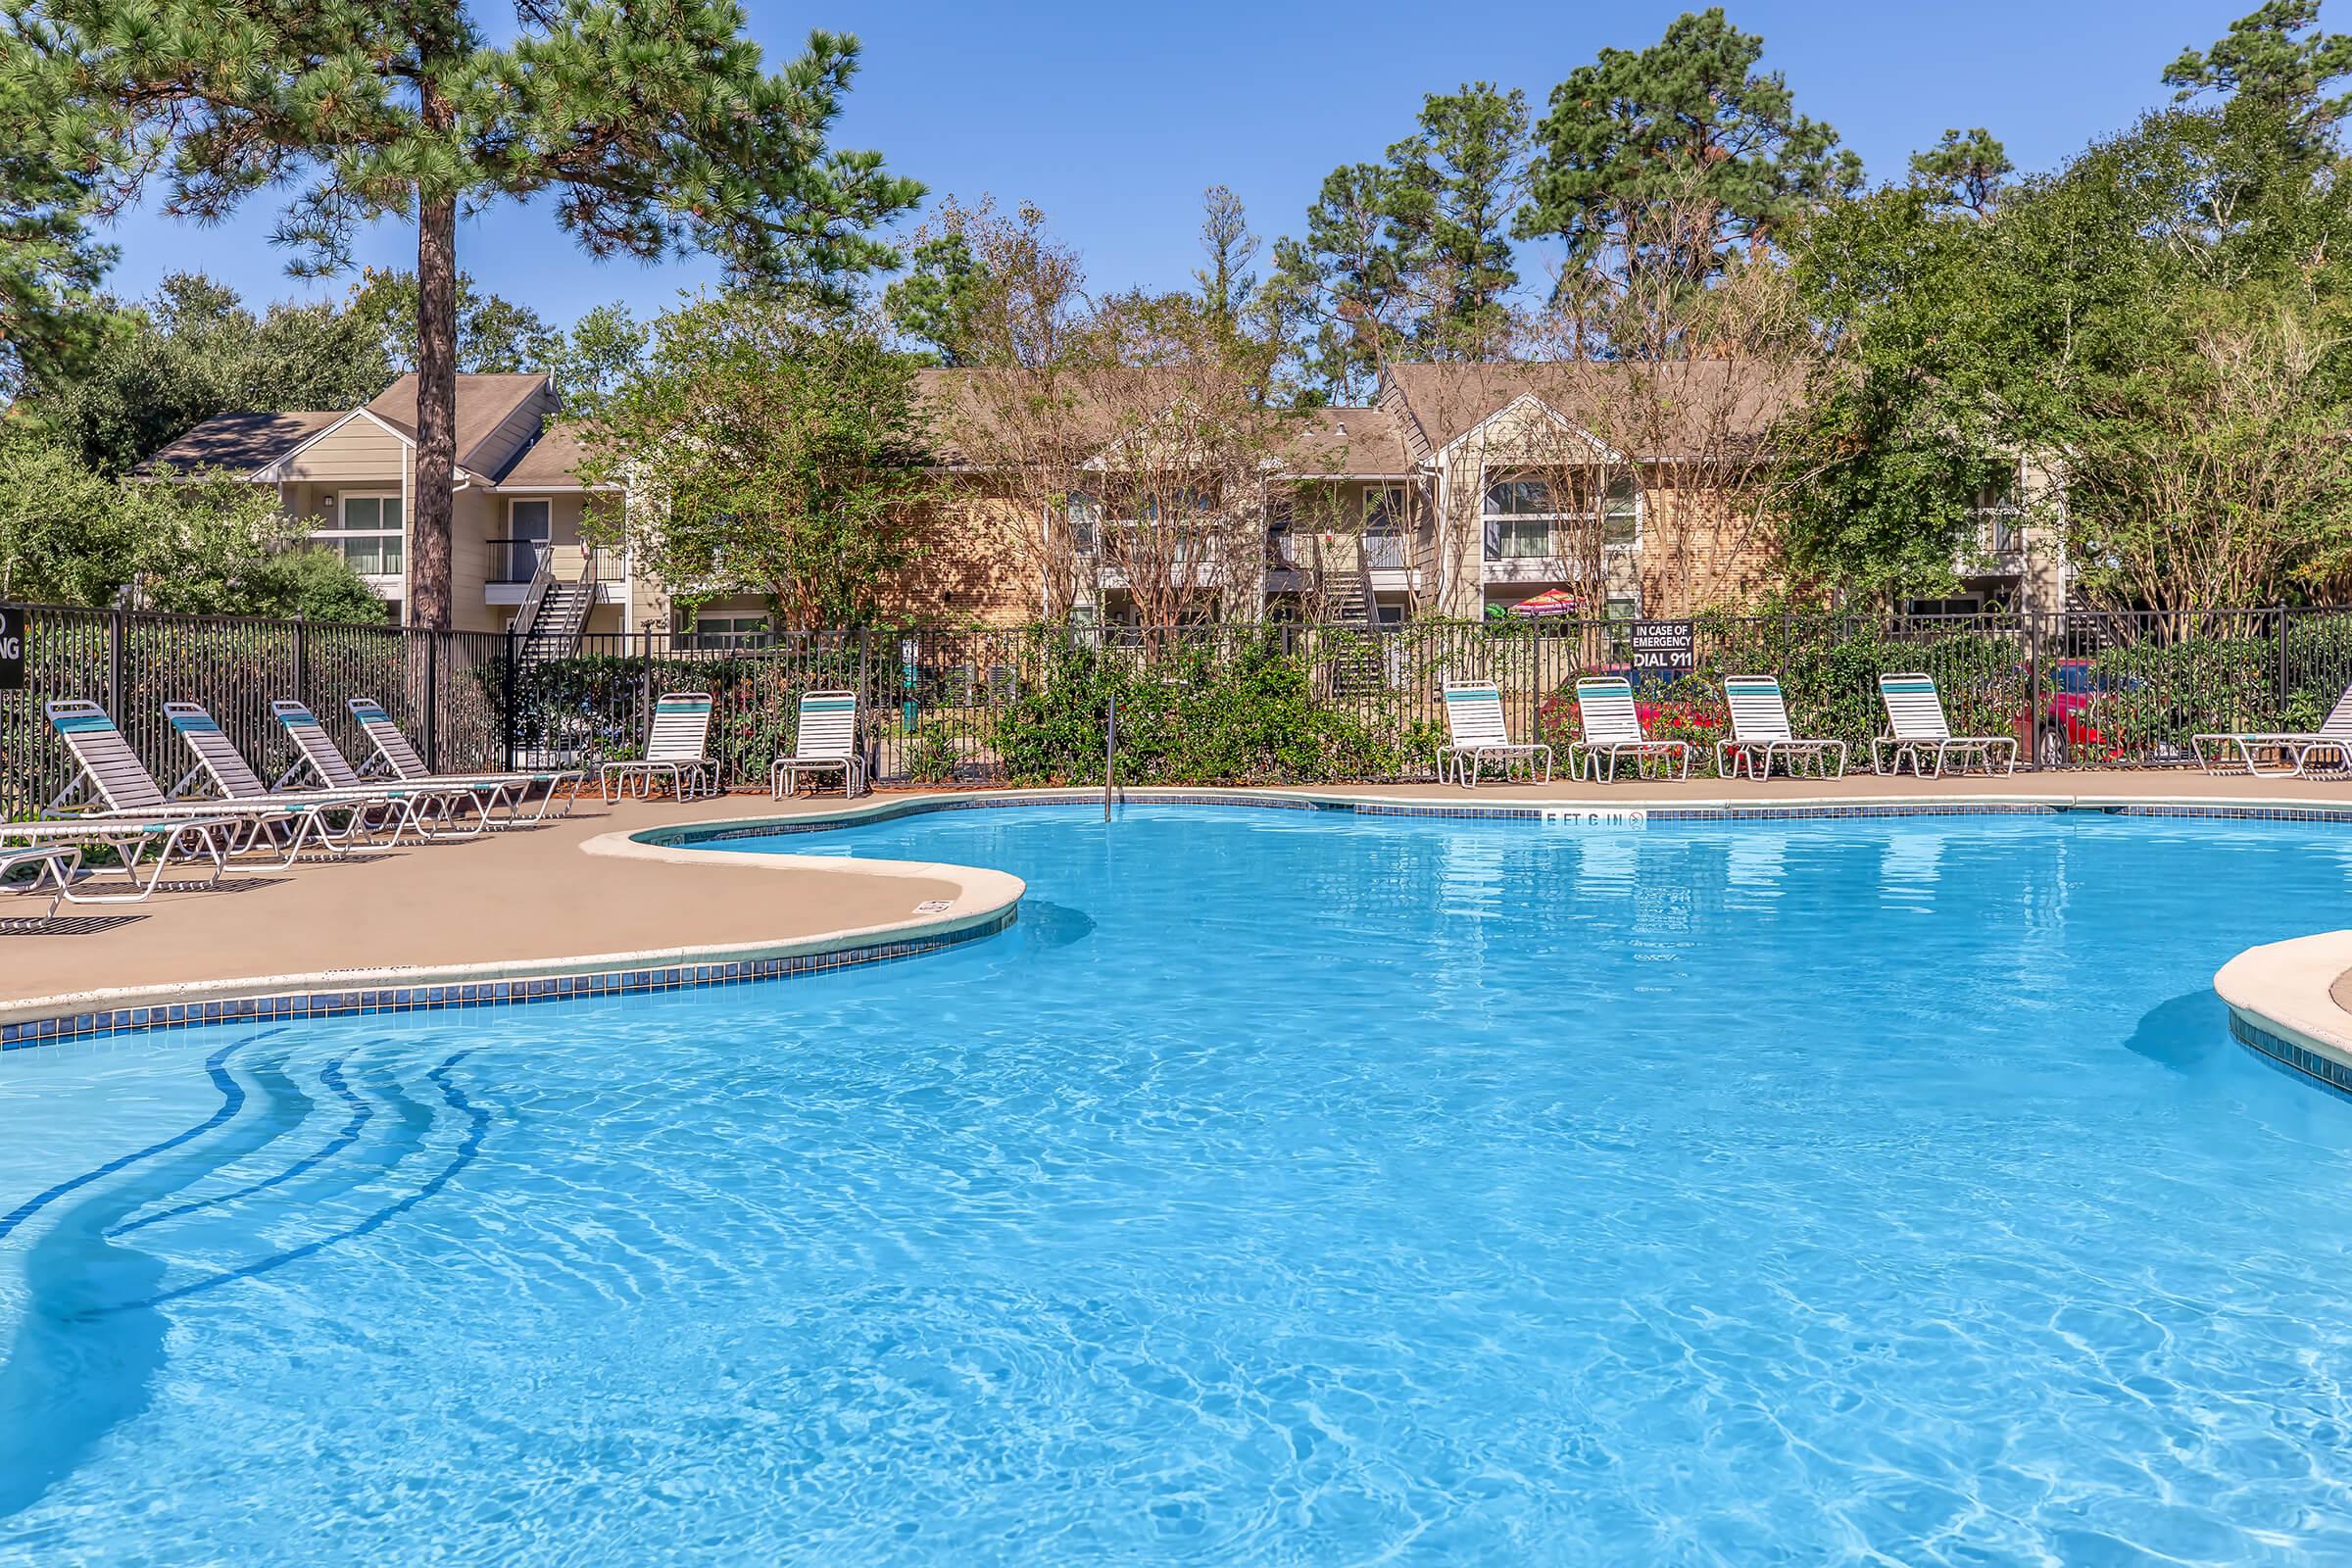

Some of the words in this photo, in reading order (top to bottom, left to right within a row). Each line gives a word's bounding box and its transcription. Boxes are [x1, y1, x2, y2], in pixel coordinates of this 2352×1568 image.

[1637, 625, 1646, 636] IN
[1648, 625, 1673, 636] CASE
[1674, 625, 1689, 635] OF
[1633, 636, 1691, 647] EMERGENCY
[1634, 653, 1668, 666] DIAL
[1670, 652, 1692, 666] 911
[1563, 813, 1581, 826] FT
[1607, 813, 1622, 826] IN
